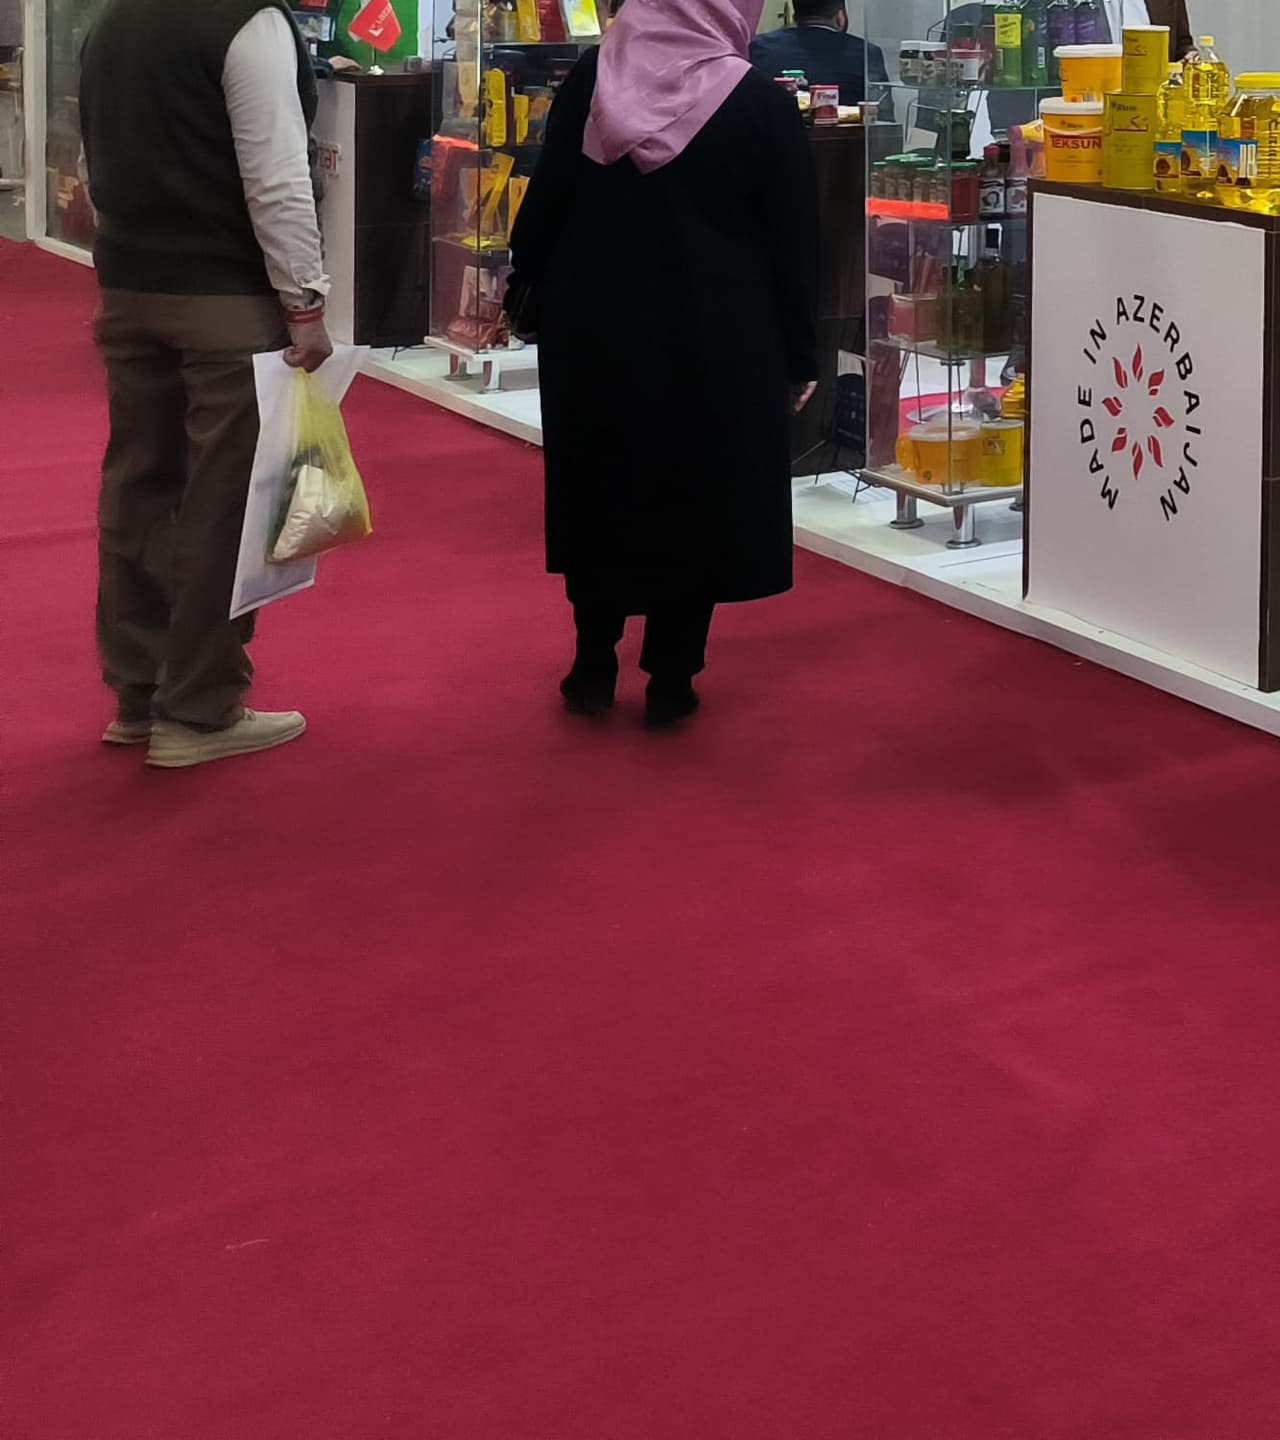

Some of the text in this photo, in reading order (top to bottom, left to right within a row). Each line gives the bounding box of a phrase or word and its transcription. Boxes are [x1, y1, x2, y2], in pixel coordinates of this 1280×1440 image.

[1050, 134, 1102, 150] TEKSUN
[1077, 294, 1202, 522] MADE IN AZERBAIJAN
